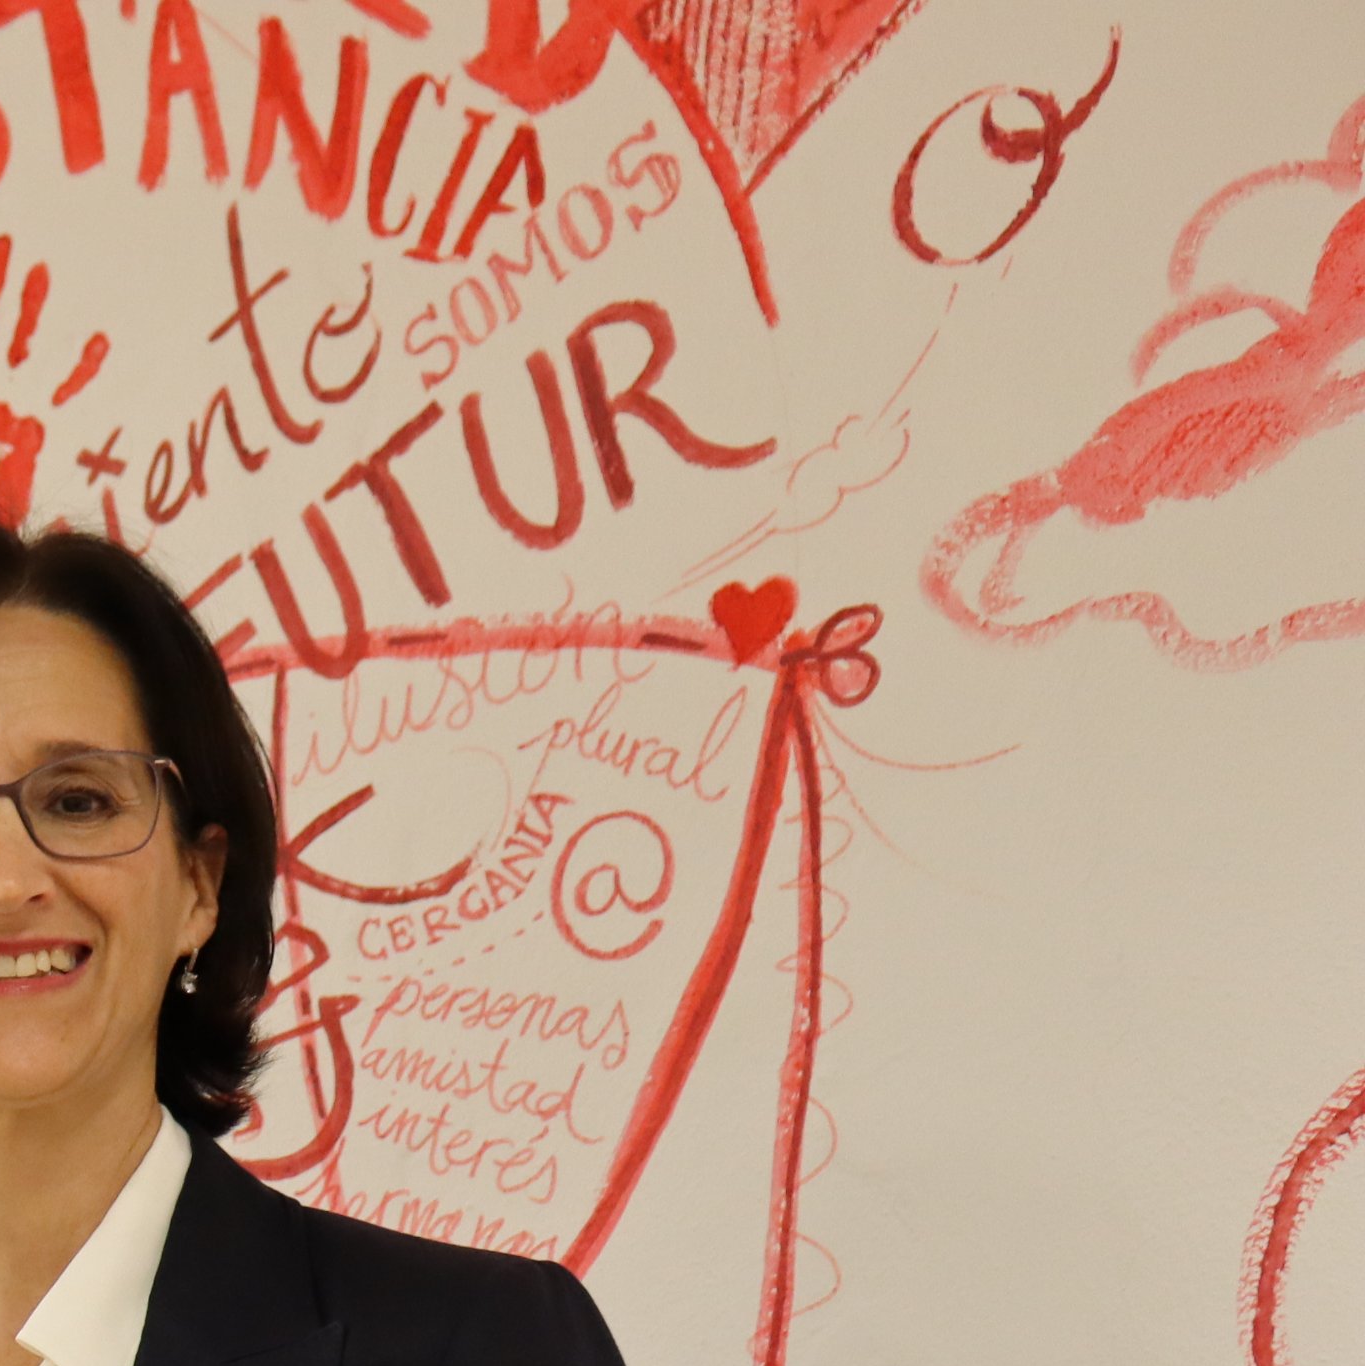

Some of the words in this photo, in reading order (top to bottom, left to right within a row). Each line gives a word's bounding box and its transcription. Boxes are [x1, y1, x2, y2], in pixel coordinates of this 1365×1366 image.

[403, 118, 682, 391] SOMOS
[291, 573, 657, 788] ilusión
[516, 681, 749, 815] plural
[361, 976, 631, 1070] personas
[357, 1088, 559, 1205] interés
[360, 1038, 605, 1145] amistad
